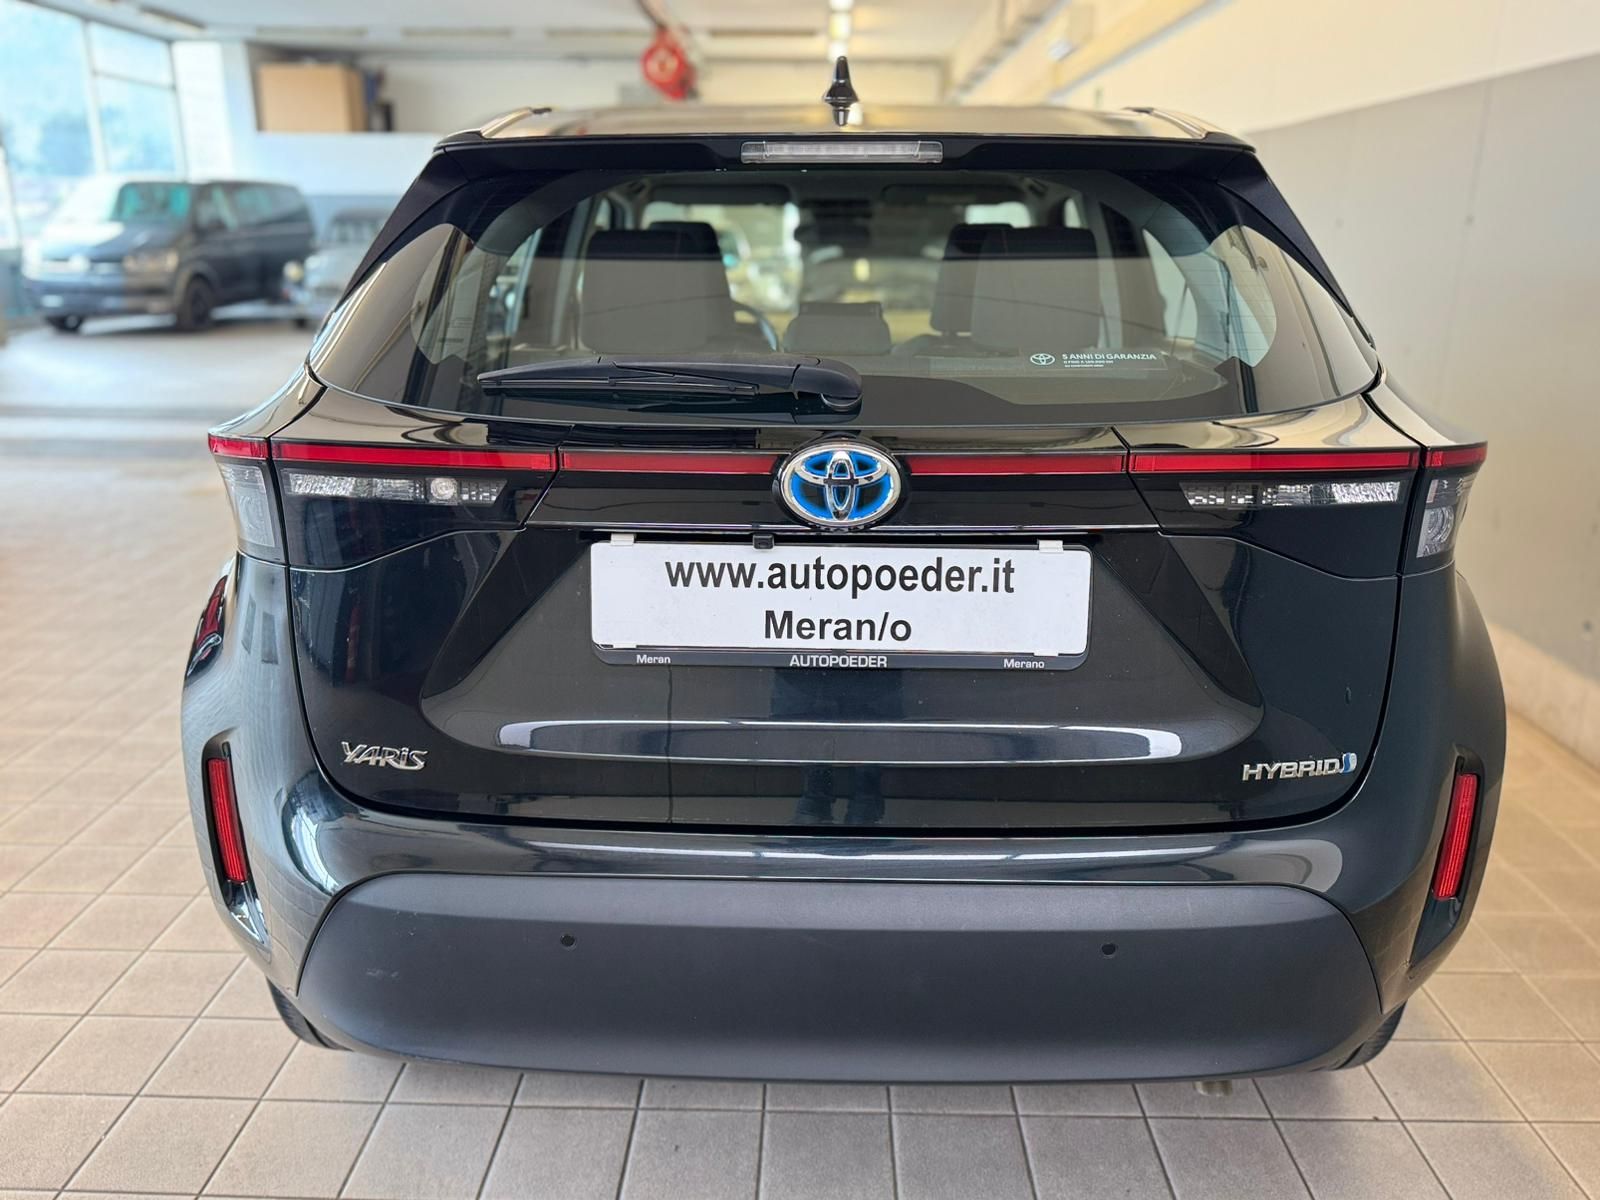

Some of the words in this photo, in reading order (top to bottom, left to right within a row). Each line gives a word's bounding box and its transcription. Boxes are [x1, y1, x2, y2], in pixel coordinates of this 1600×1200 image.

[665, 556, 1015, 600] www.autopoeder.it
[764, 610, 912, 642] Meran/o
[636, 654, 671, 665] Meran
[789, 655, 888, 669] AUTOPOEDER
[1003, 658, 1046, 670] Merano
[1242, 758, 1341, 781] HYBRID
